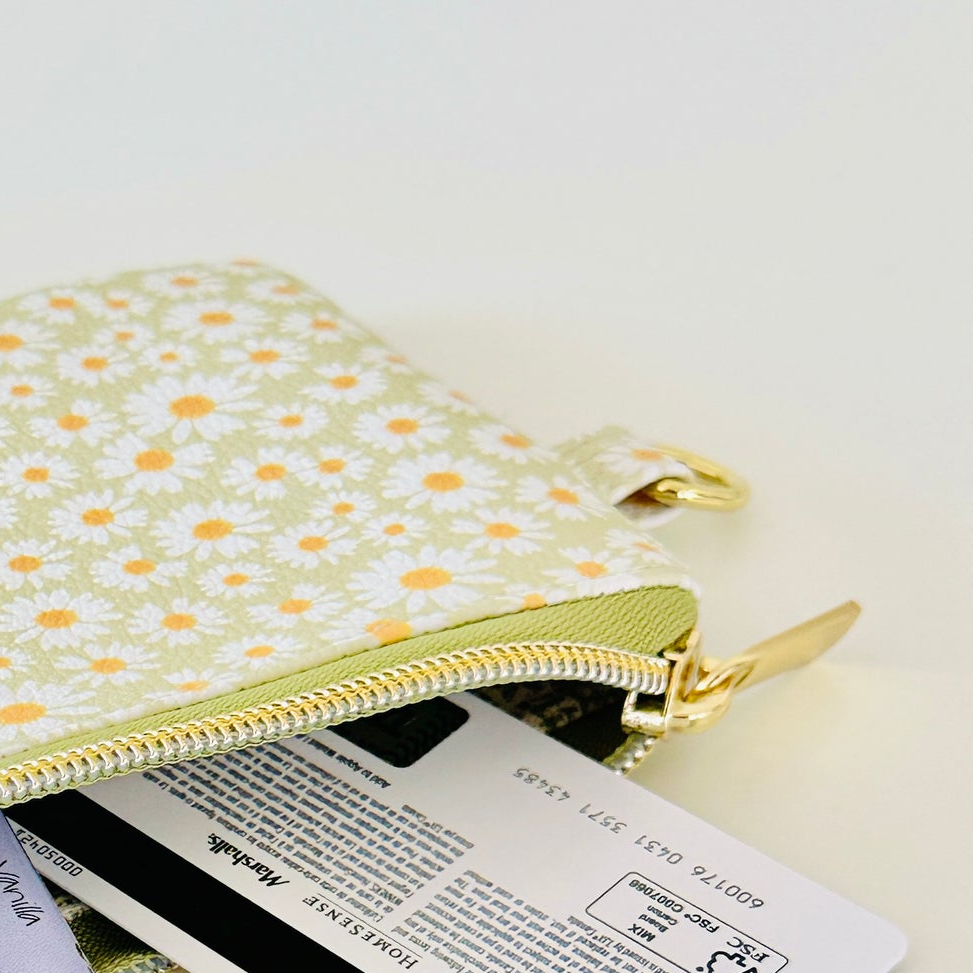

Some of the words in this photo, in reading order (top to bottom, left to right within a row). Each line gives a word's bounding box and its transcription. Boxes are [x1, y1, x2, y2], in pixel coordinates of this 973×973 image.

[510, 765, 574, 803] 43485
[576, 802, 629, 834] 3571
[632, 833, 685, 866] 0431
[686, 863, 766, 912] 600176
[626, 922, 657, 943] MIX
[724, 934, 770, 964] FSC
